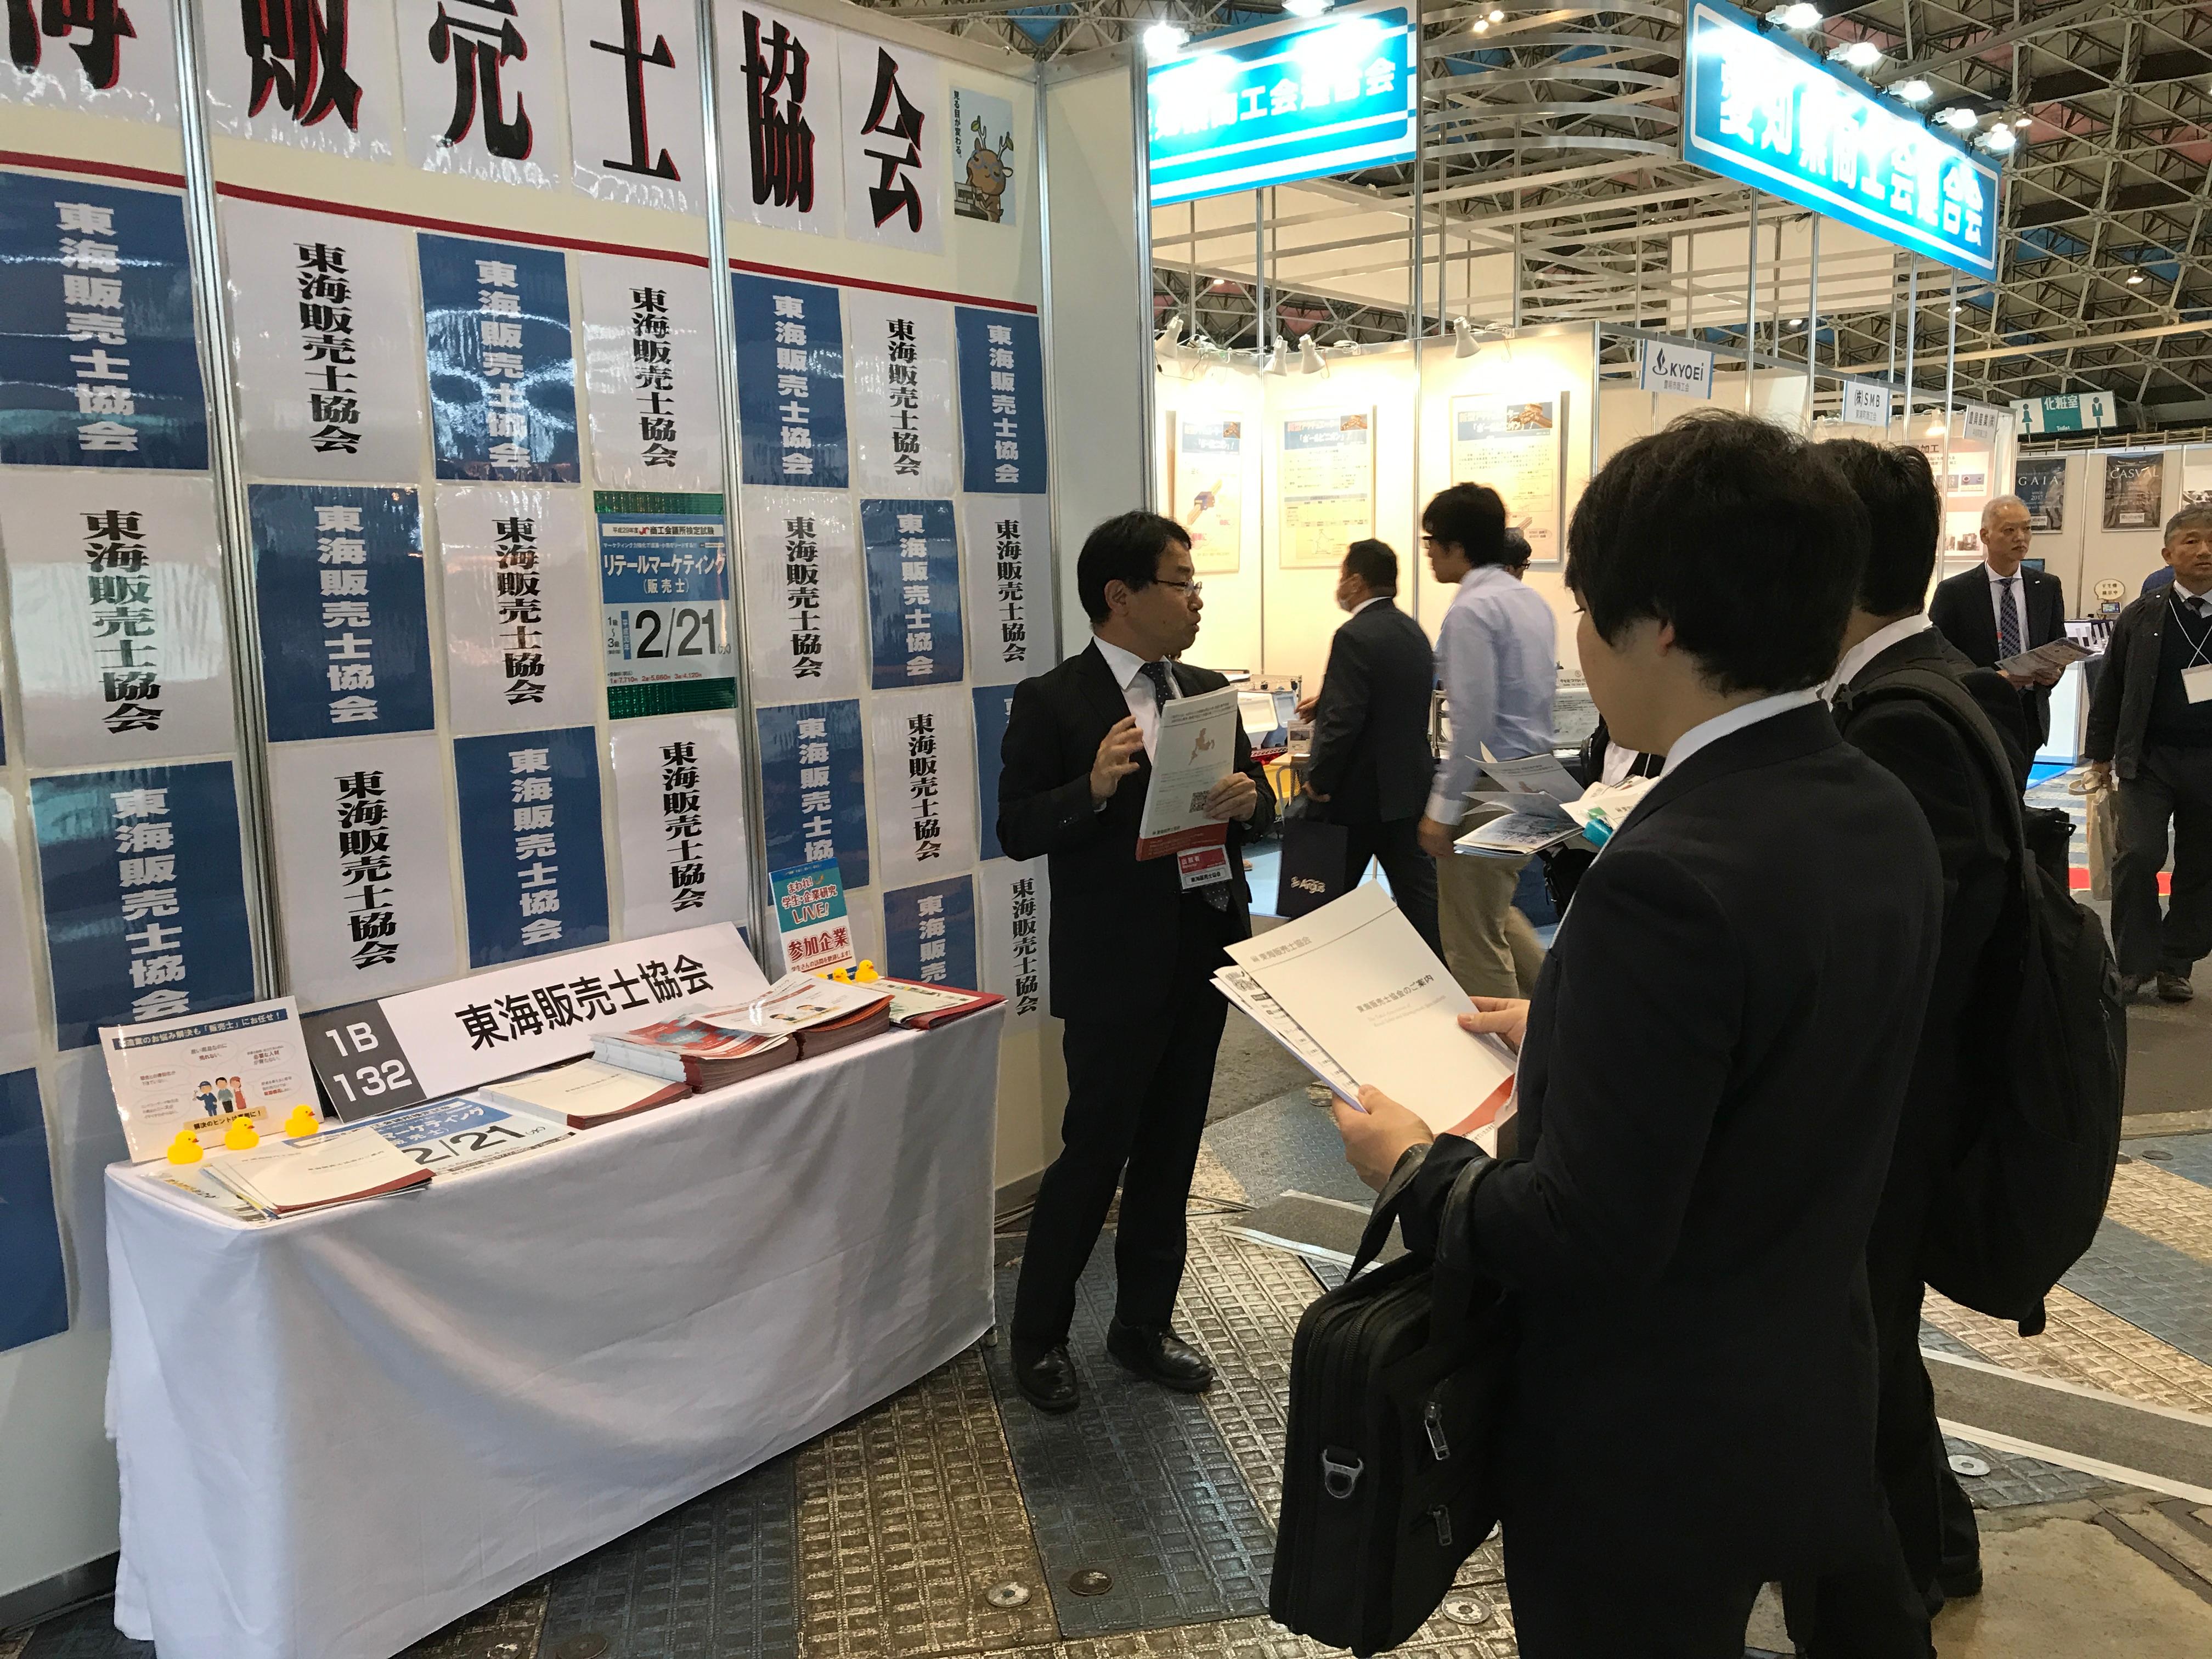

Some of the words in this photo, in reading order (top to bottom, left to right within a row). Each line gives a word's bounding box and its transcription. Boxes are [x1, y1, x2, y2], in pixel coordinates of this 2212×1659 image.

[54, 201, 138, 453] 東海販売士協会
[293, 242, 362, 454] 東海販売士協会
[475, 259, 532, 470] 東海販売士協会
[629, 286, 678, 467] 東海販売士協会
[772, 295, 813, 476] 東海販売士協会
[885, 318, 921, 477] 東海販売士協会
[986, 324, 1019, 484] 東海販売士協会
[2044, 394, 2079, 411] 化粧室
[2018, 475, 2059, 486] GAIA
[2109, 467, 2159, 479] CASVAL
[80, 510, 164, 733] 東海販売士協会
[314, 505, 379, 724] 東海販売士協会
[491, 517, 546, 706] 東海販売士協会
[603, 553, 727, 577] リテールマーケティング
[635, 607, 716, 659] 2/21
[783, 516, 822, 679] 東海販売士協会
[897, 514, 934, 677] 東海販売士協会
[994, 519, 1026, 664] 東海販売士協会
[508, 748, 562, 945] 東海販売士協会
[658, 741, 708, 912] 東海販売士協会
[906, 713, 941, 862] 東海販売士協会
[110, 788, 190, 1023] 東海販売士協会
[334, 770, 399, 970] 東海販売士協会
[788, 926, 848, 962] 参加企業
[792, 901, 830, 924] LIVE!
[455, 953, 714, 1052] 東海販売士協会
[1009, 878, 1039, 1018] 東海販売士協会
[1259, 935, 1313, 962] 東海販売士協会
[1356, 974, 1435, 1013] 東海販売士協会のご案内
[325, 1021, 379, 1058] 1B
[333, 1059, 413, 1103] 132
[401, 1125, 526, 1165] 2/21
